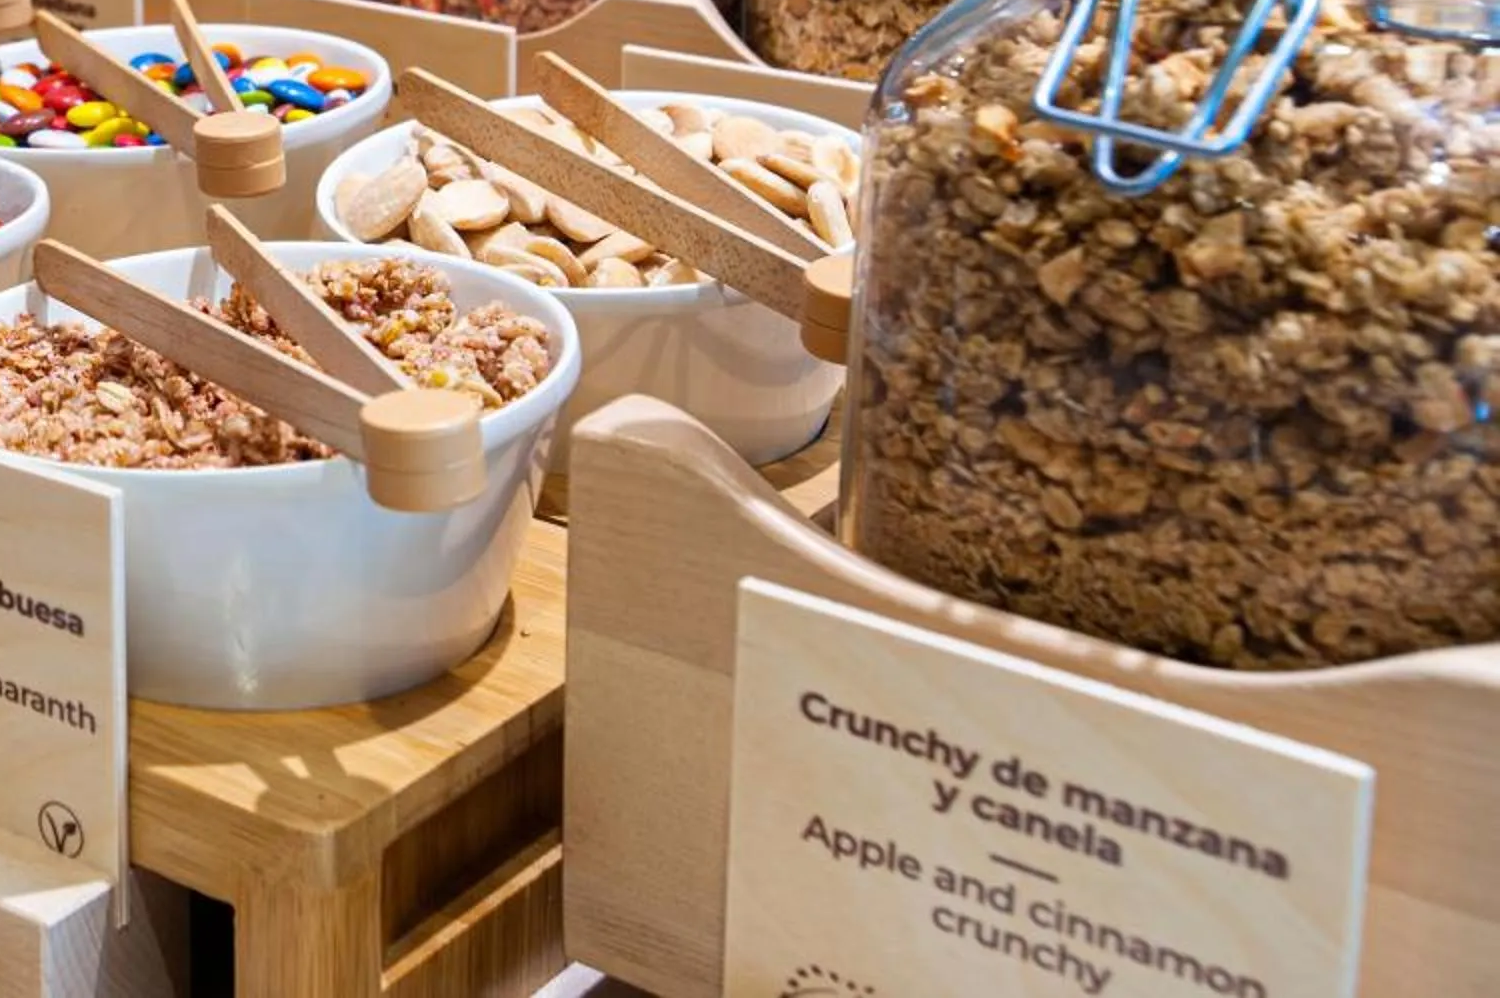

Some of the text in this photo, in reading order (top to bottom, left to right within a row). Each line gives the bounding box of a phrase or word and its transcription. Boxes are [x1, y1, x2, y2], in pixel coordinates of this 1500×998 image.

[799, 691, 1290, 881] Crunchy de manzana
[931, 779, 1124, 868] y canela
[802, 814, 1268, 998] Apple and cinnamon
[931, 905, 1112, 996] crunchy
